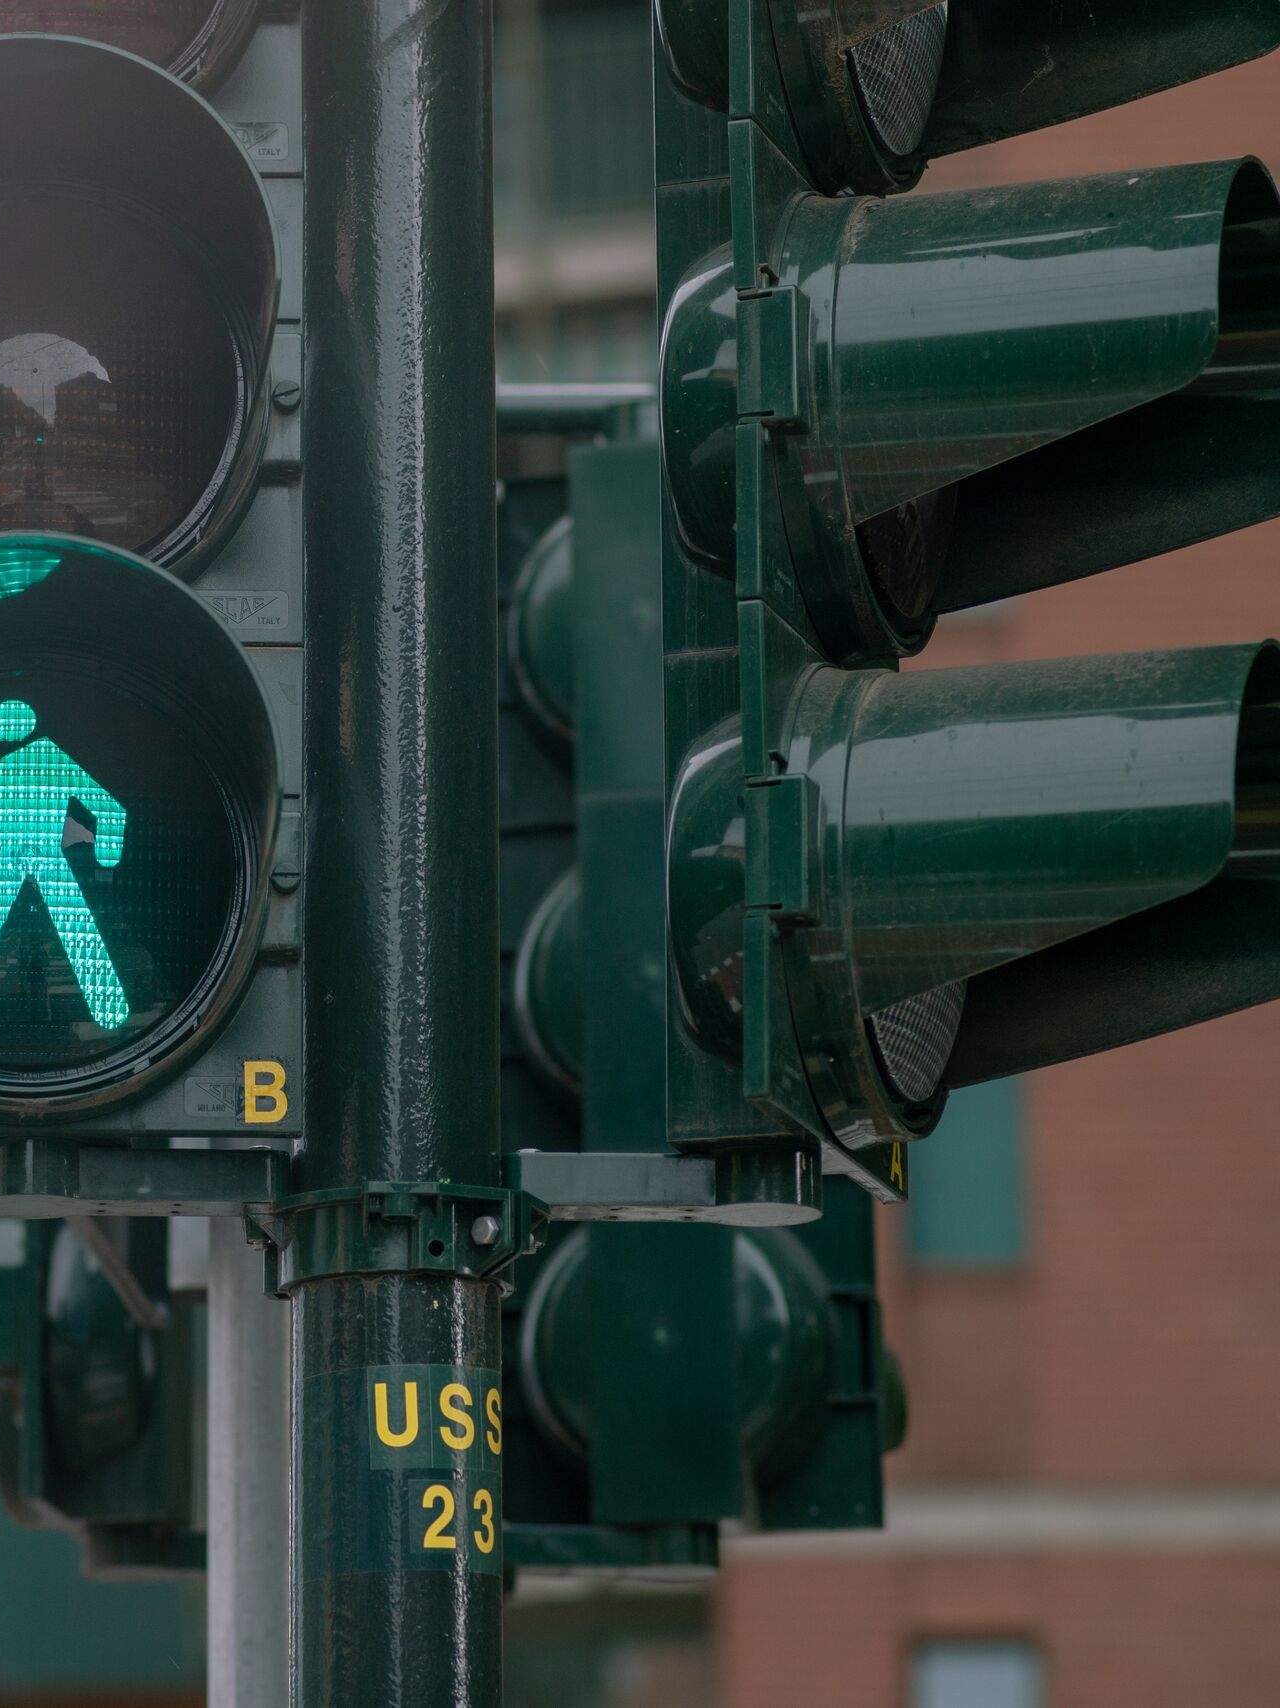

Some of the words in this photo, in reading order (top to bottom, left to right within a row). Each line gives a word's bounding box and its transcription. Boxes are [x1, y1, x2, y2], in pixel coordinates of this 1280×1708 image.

[257, 147, 281, 156] ITALY
[257, 617, 281, 625] ITALY
[244, 1060, 288, 1123] B
[890, 1139, 903, 1191] A
[374, 1381, 503, 1455] USS
[422, 1484, 495, 1554] 23
